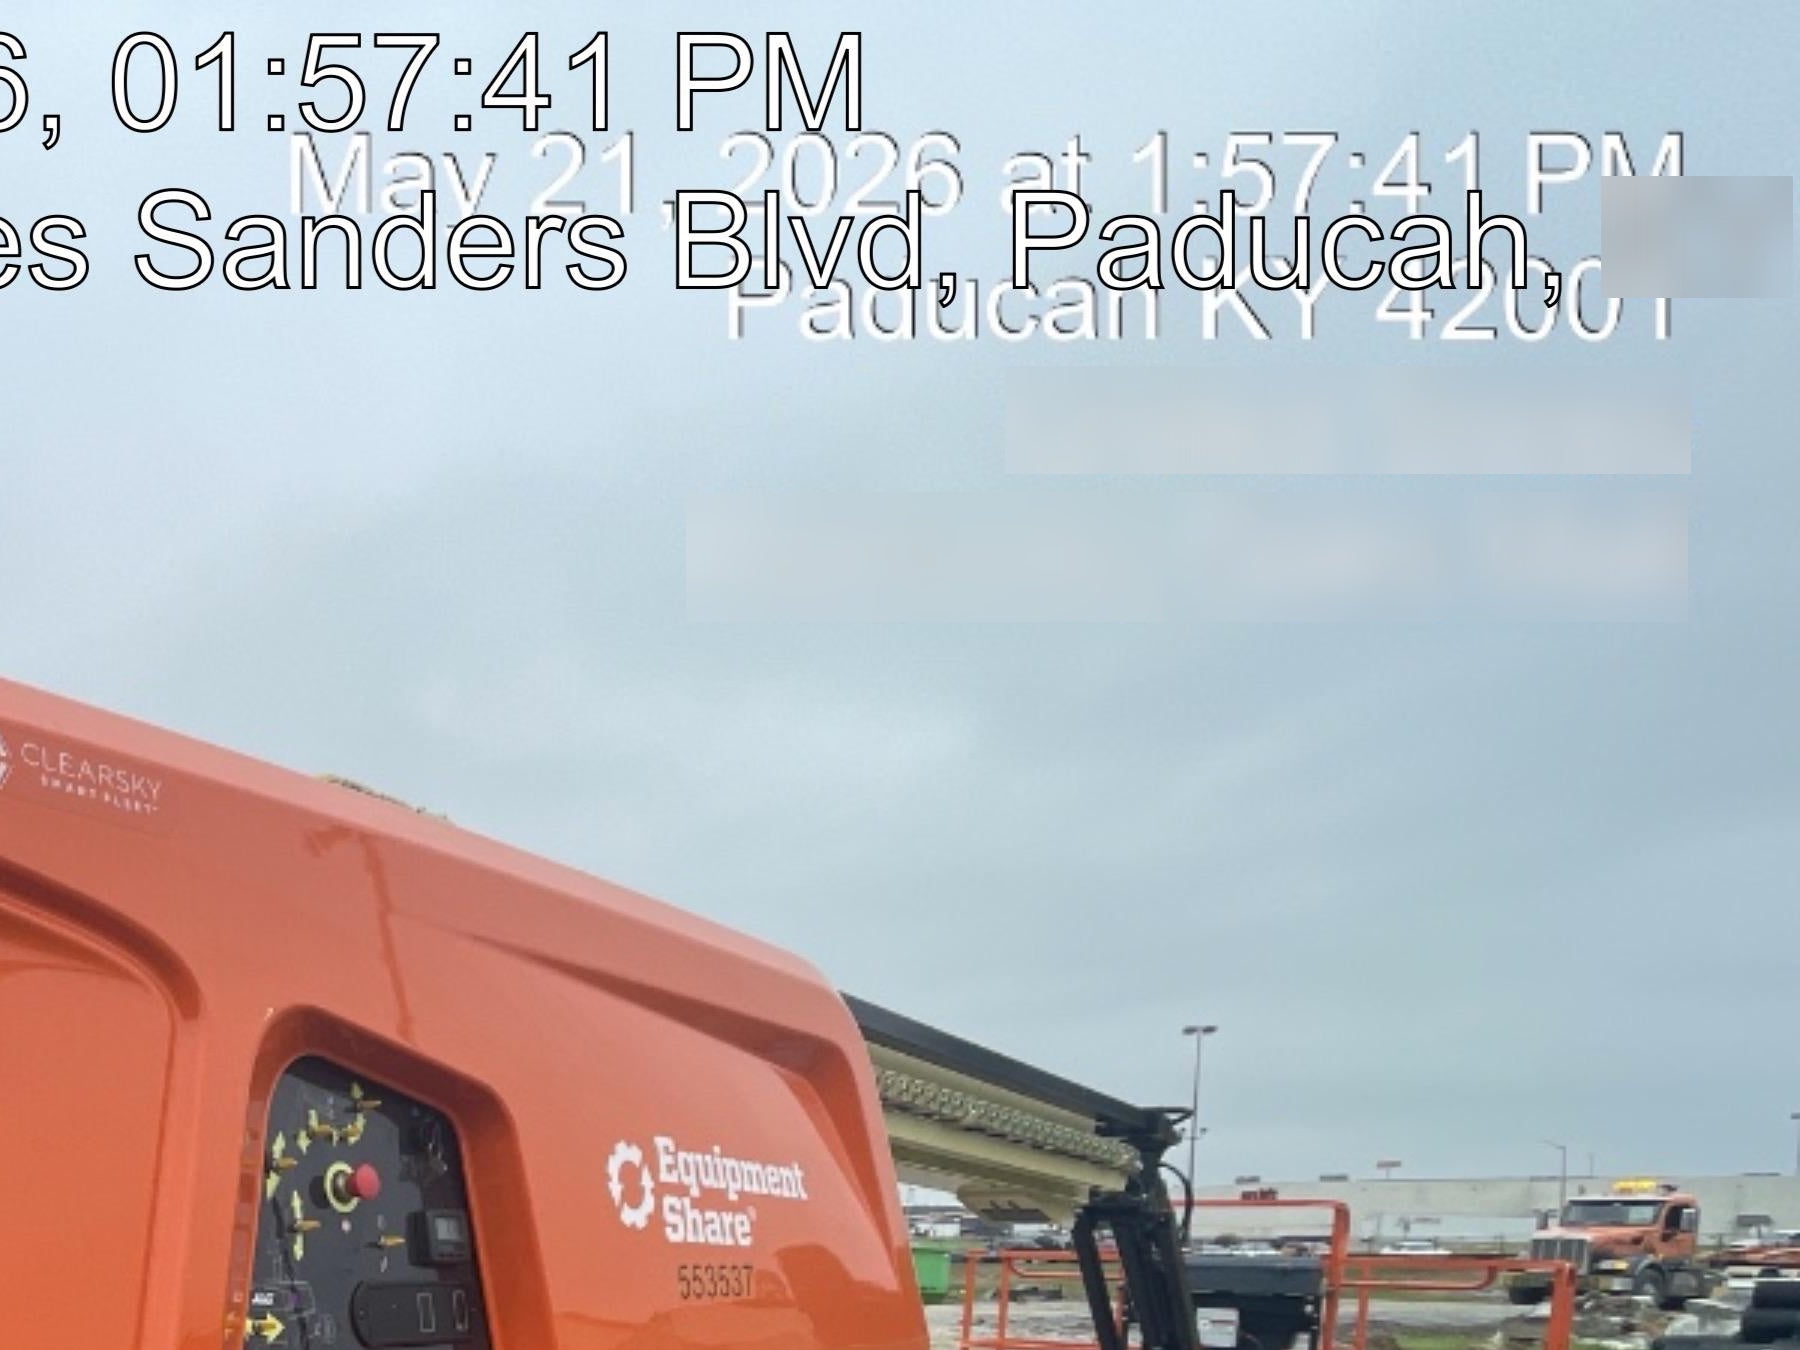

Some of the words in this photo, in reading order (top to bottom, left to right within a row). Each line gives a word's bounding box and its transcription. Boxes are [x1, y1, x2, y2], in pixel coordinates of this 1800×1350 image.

[20, 742, 162, 799] CLEARSKY
[654, 1136, 808, 1200] Equipment
[663, 1195, 754, 1246] Share
[677, 1265, 753, 1299] 553537
